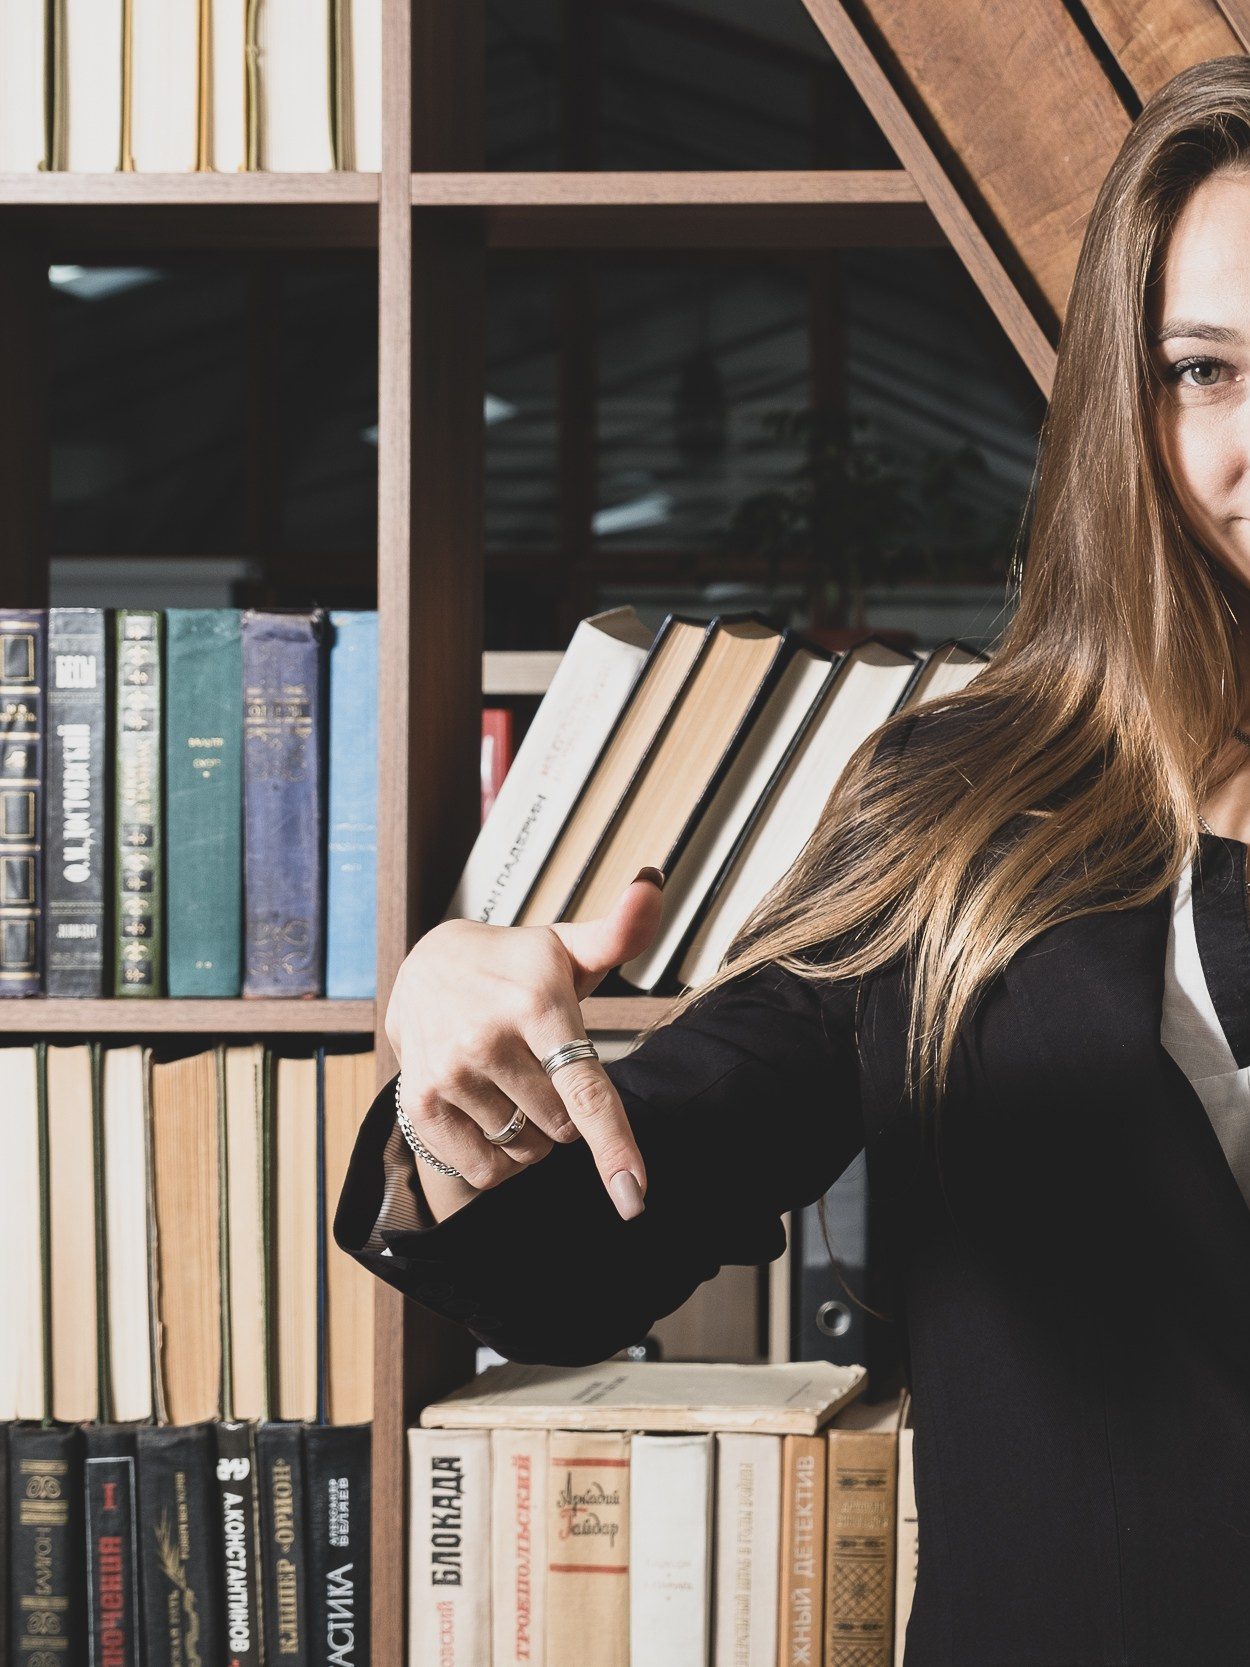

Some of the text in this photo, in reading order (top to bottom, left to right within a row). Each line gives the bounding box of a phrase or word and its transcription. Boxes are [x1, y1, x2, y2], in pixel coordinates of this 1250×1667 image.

[327, 1478, 339, 1547] АЛЕКСАНДР
[338, 1477, 349, 1547] БЕЛЯЕВ
[431, 1456, 466, 1587] БЛОКАДА
[557, 1471, 620, 1516] Аркадий
[558, 1507, 619, 1547] Гайдар
[794, 1455, 815, 1579] ДЕТЕКТИВ
[511, 1453, 531, 1662] ТРОЕПОЛЬСКИЙ
[325, 1562, 355, 1667] АСТИКА
